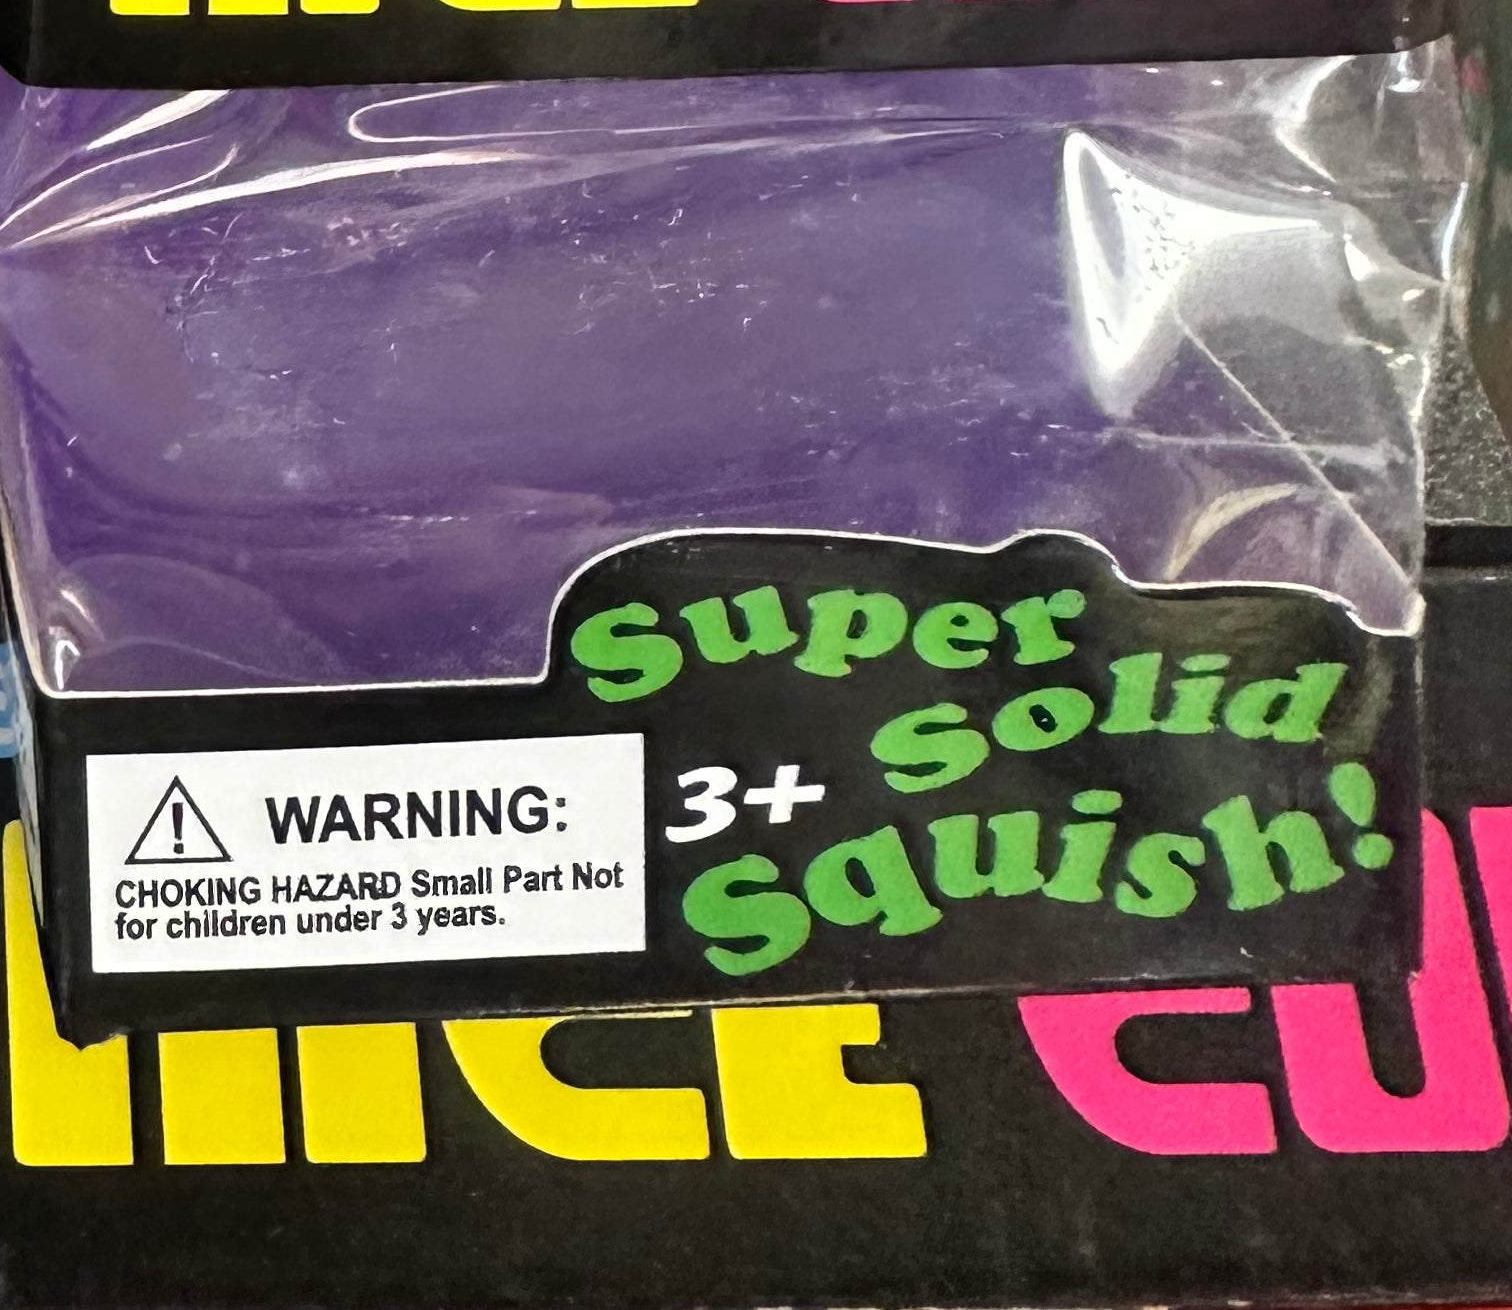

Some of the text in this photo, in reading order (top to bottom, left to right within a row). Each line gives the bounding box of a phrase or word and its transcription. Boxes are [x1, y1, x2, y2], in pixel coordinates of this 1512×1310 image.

[570, 585, 1088, 702] Super
[265, 786, 568, 845] WARNING:
[665, 764, 826, 843] 3+
[115, 861, 624, 910] CHOKING HAZARD Small Part Not
[682, 759, 1394, 977] Squish!
[115, 902, 506, 940] for children under 3 years.
